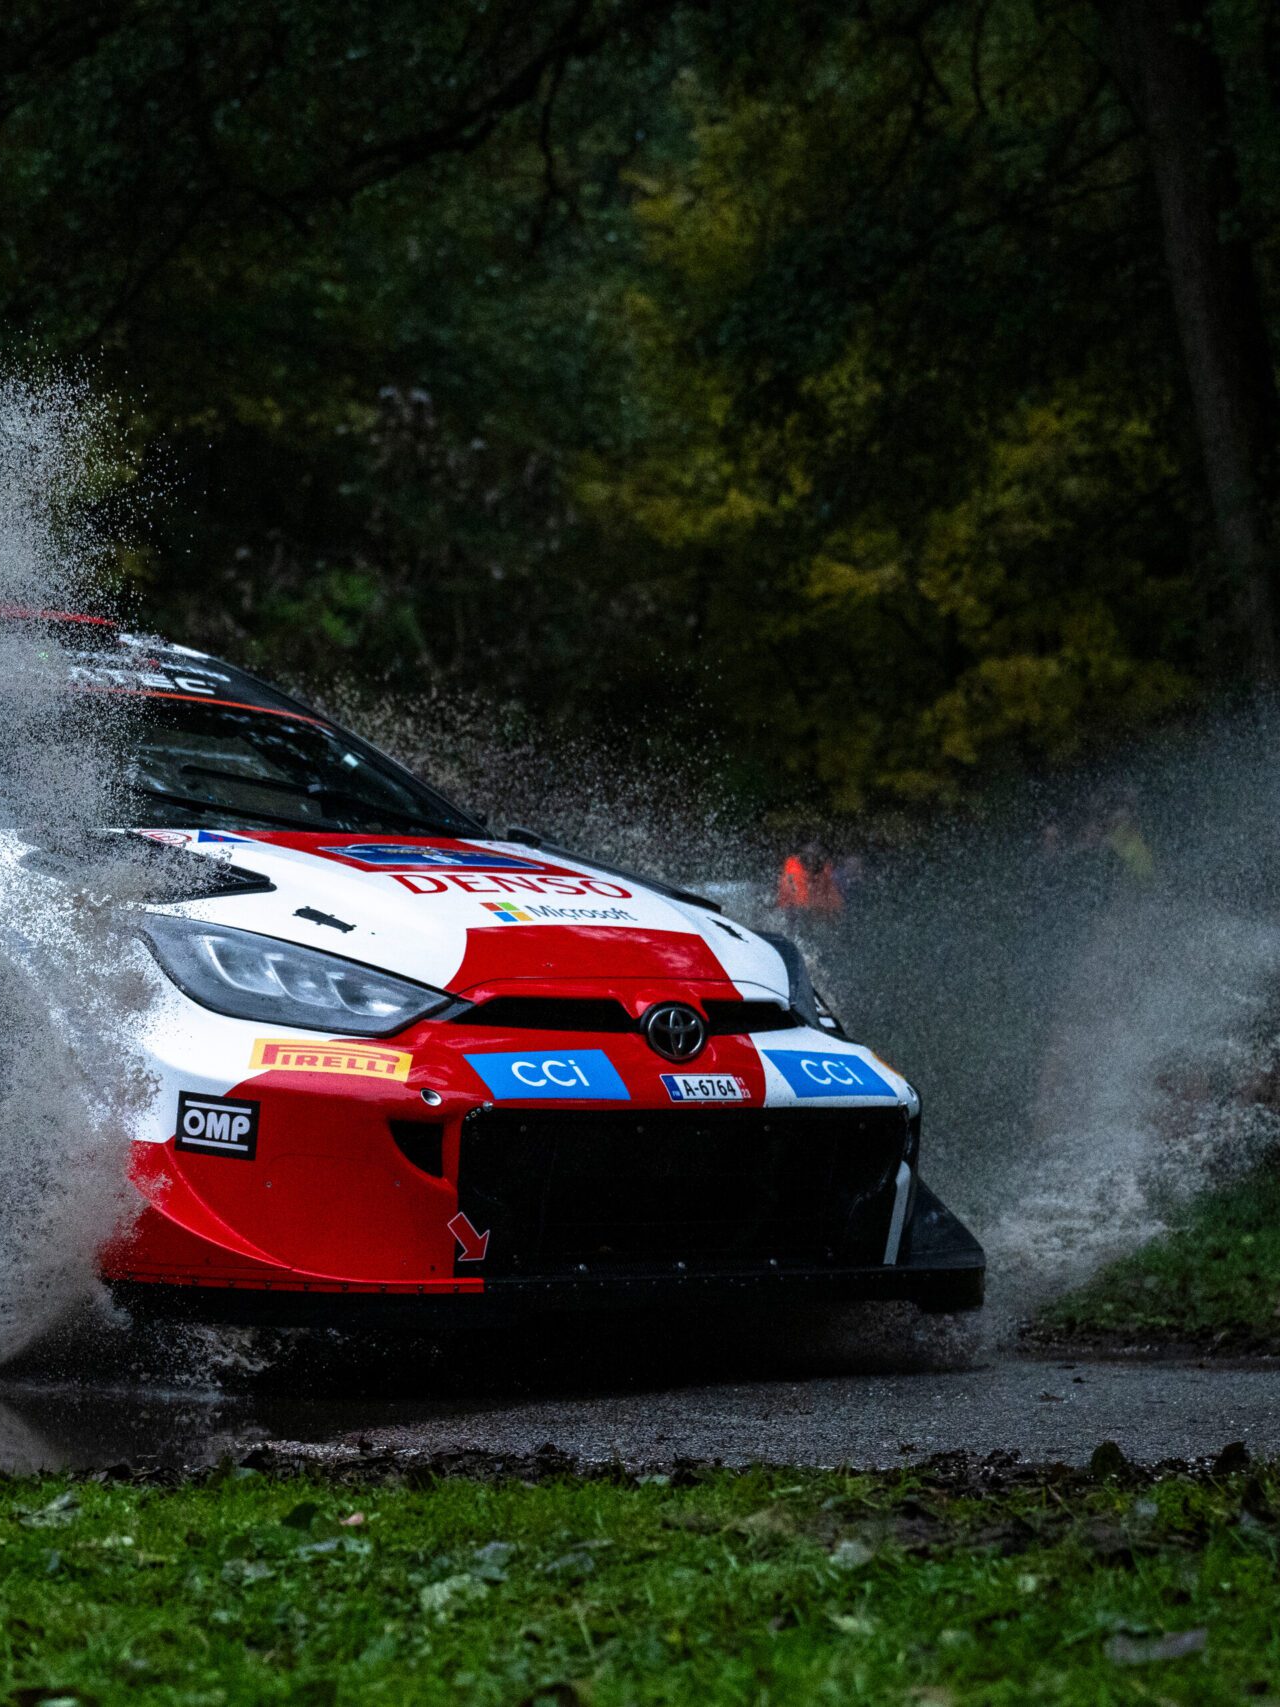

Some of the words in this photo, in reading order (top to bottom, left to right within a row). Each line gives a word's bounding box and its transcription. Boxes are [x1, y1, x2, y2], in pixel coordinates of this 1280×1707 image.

[387, 874, 633, 899] DENSO
[524, 904, 638, 921] Microsoft
[261, 1043, 401, 1075] PIRELLI
[682, 1079, 737, 1097] A-6764
[183, 1109, 251, 1143] OMP
